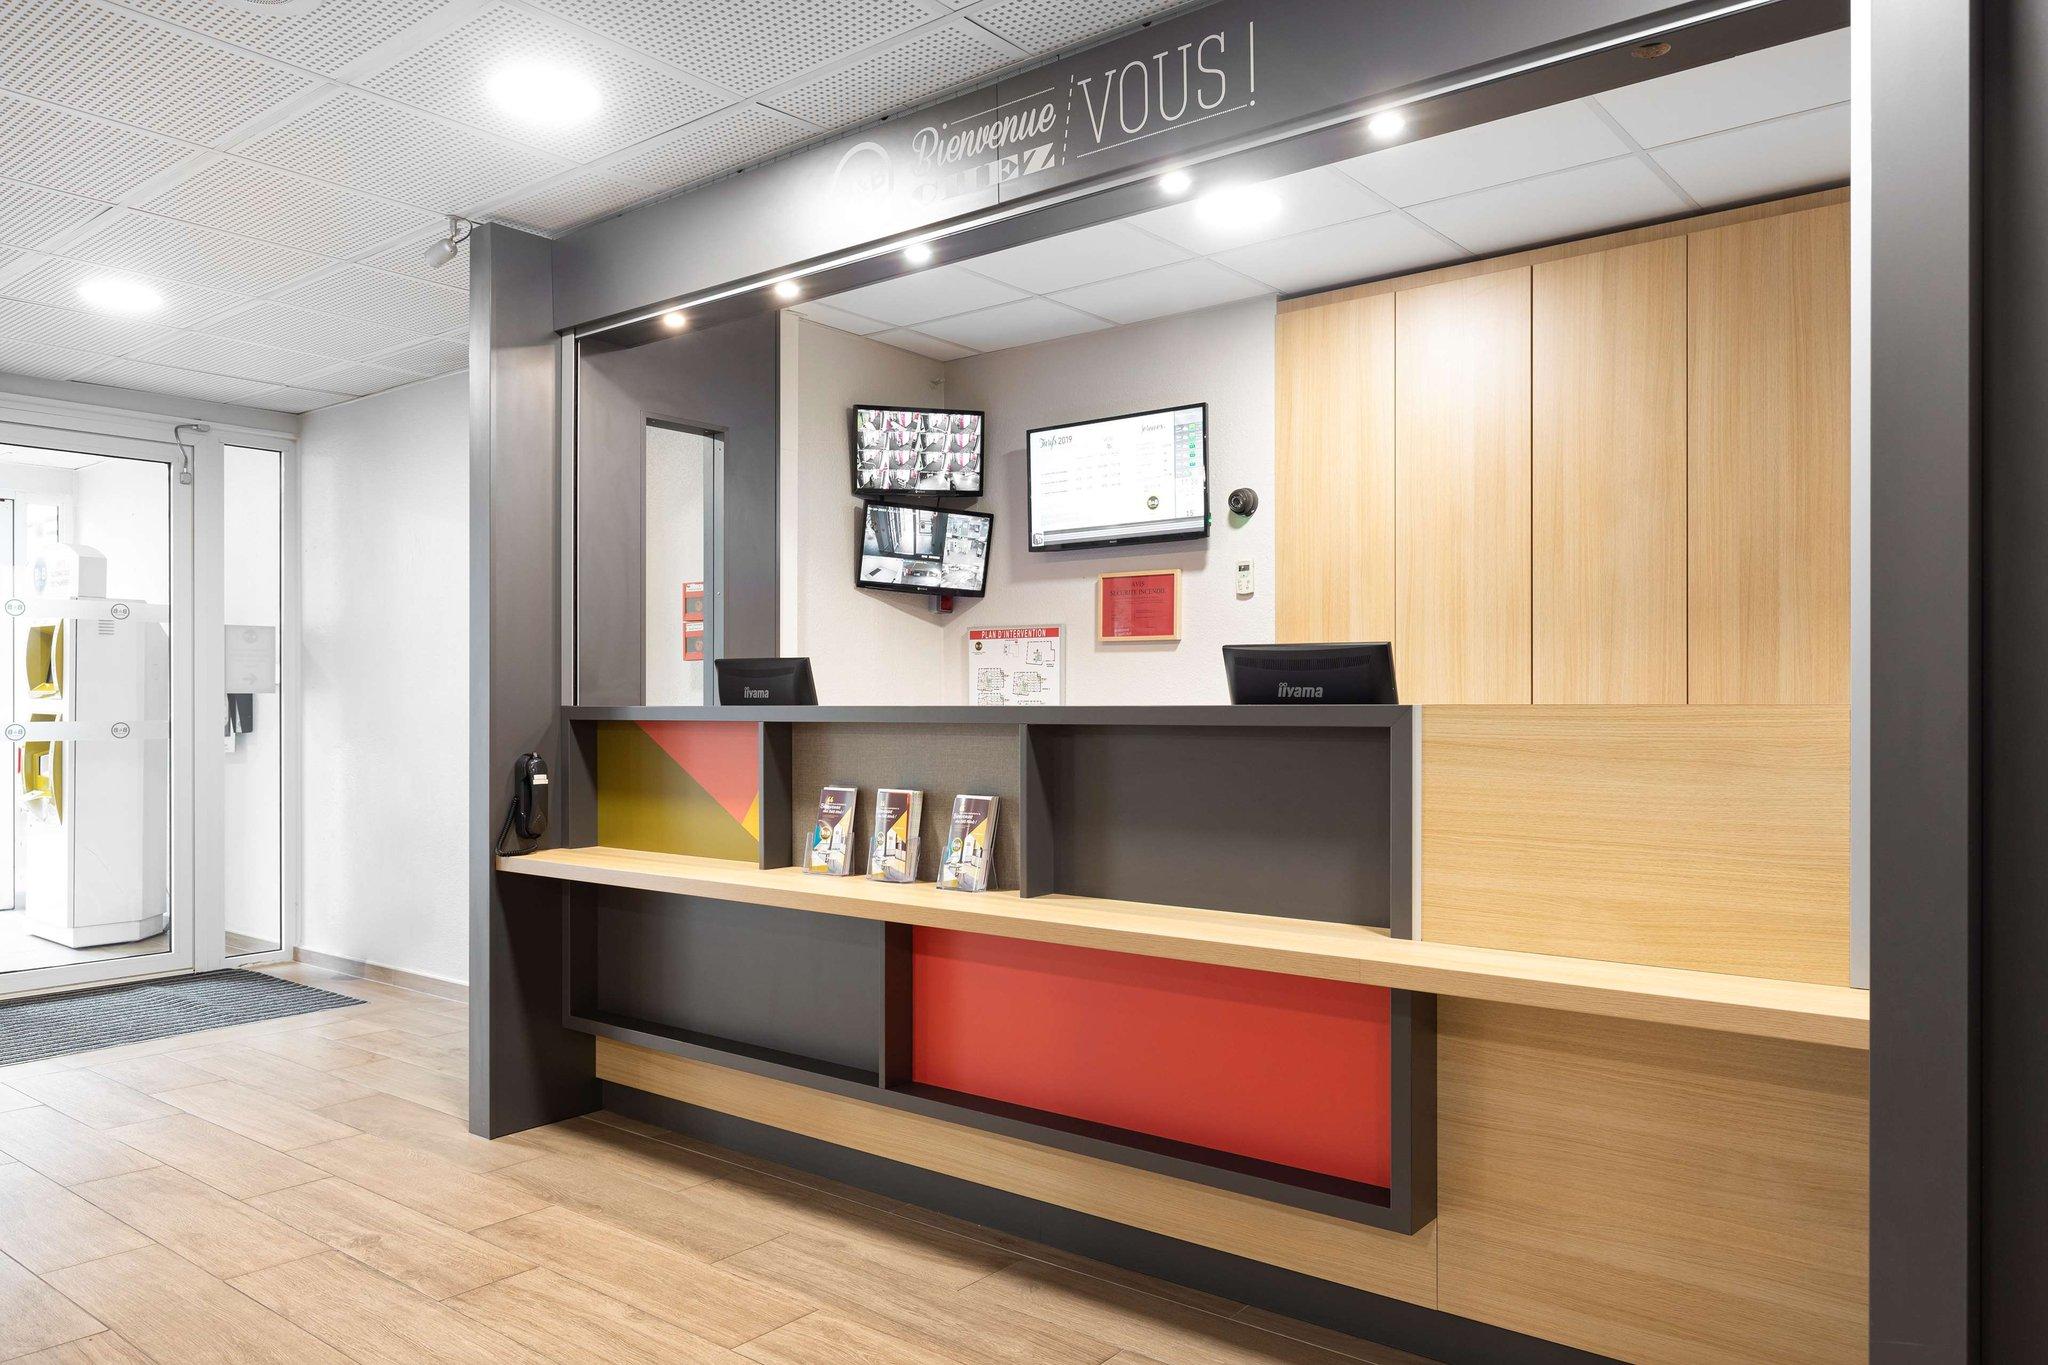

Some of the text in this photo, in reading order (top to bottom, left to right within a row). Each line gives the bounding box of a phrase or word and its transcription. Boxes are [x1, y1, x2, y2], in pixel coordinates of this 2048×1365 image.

[912, 102, 1057, 177] Bienvenue
[1058, 435, 1073, 445] 2019
[981, 628, 1047, 639] PLAN D'INTERVENTION
[744, 687, 770, 698] iiyama
[1277, 682, 1324, 698] iiyama
